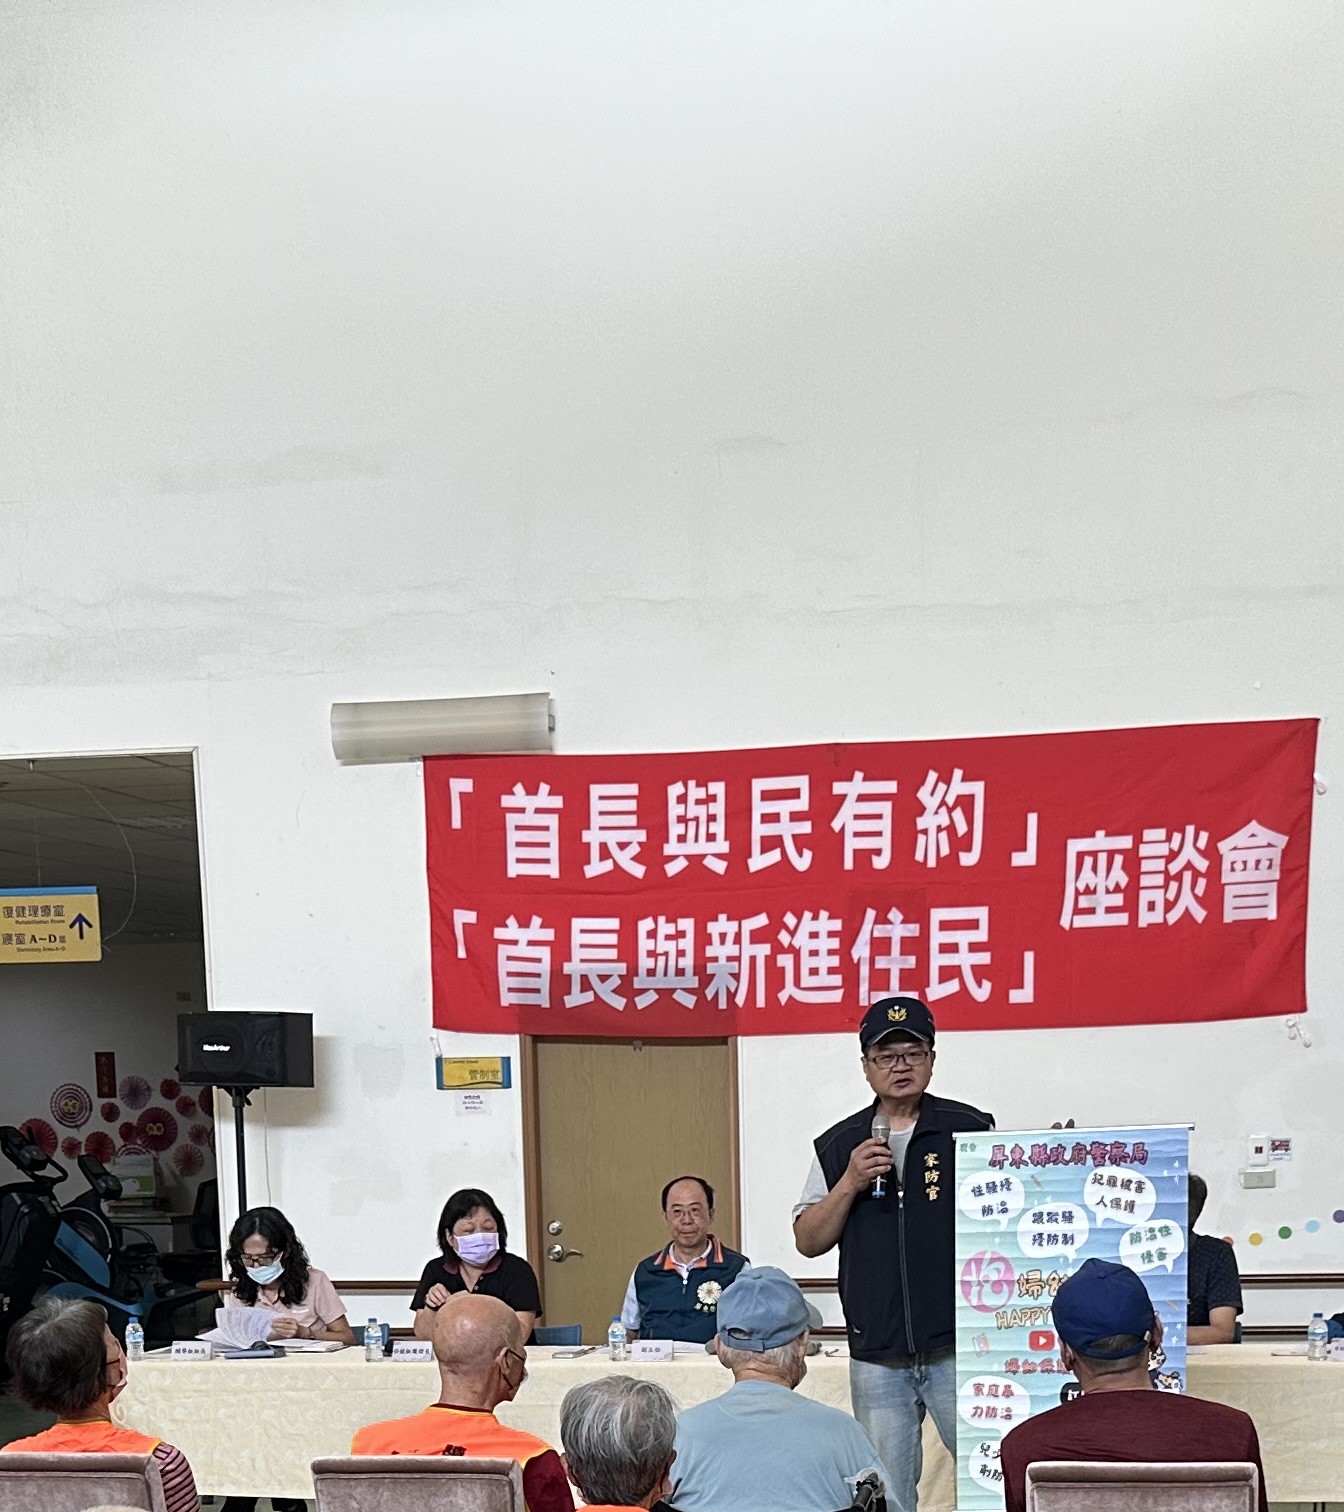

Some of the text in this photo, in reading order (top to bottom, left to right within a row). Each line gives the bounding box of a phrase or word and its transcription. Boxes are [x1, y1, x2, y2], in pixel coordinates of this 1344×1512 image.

[1059, 819, 1289, 931] 座談會
[988, 1141, 1149, 1170] 屏東縣政府警察局
[923, 1152, 941, 1201] 家防官
[995, 1306, 1051, 1330] HAPPY
